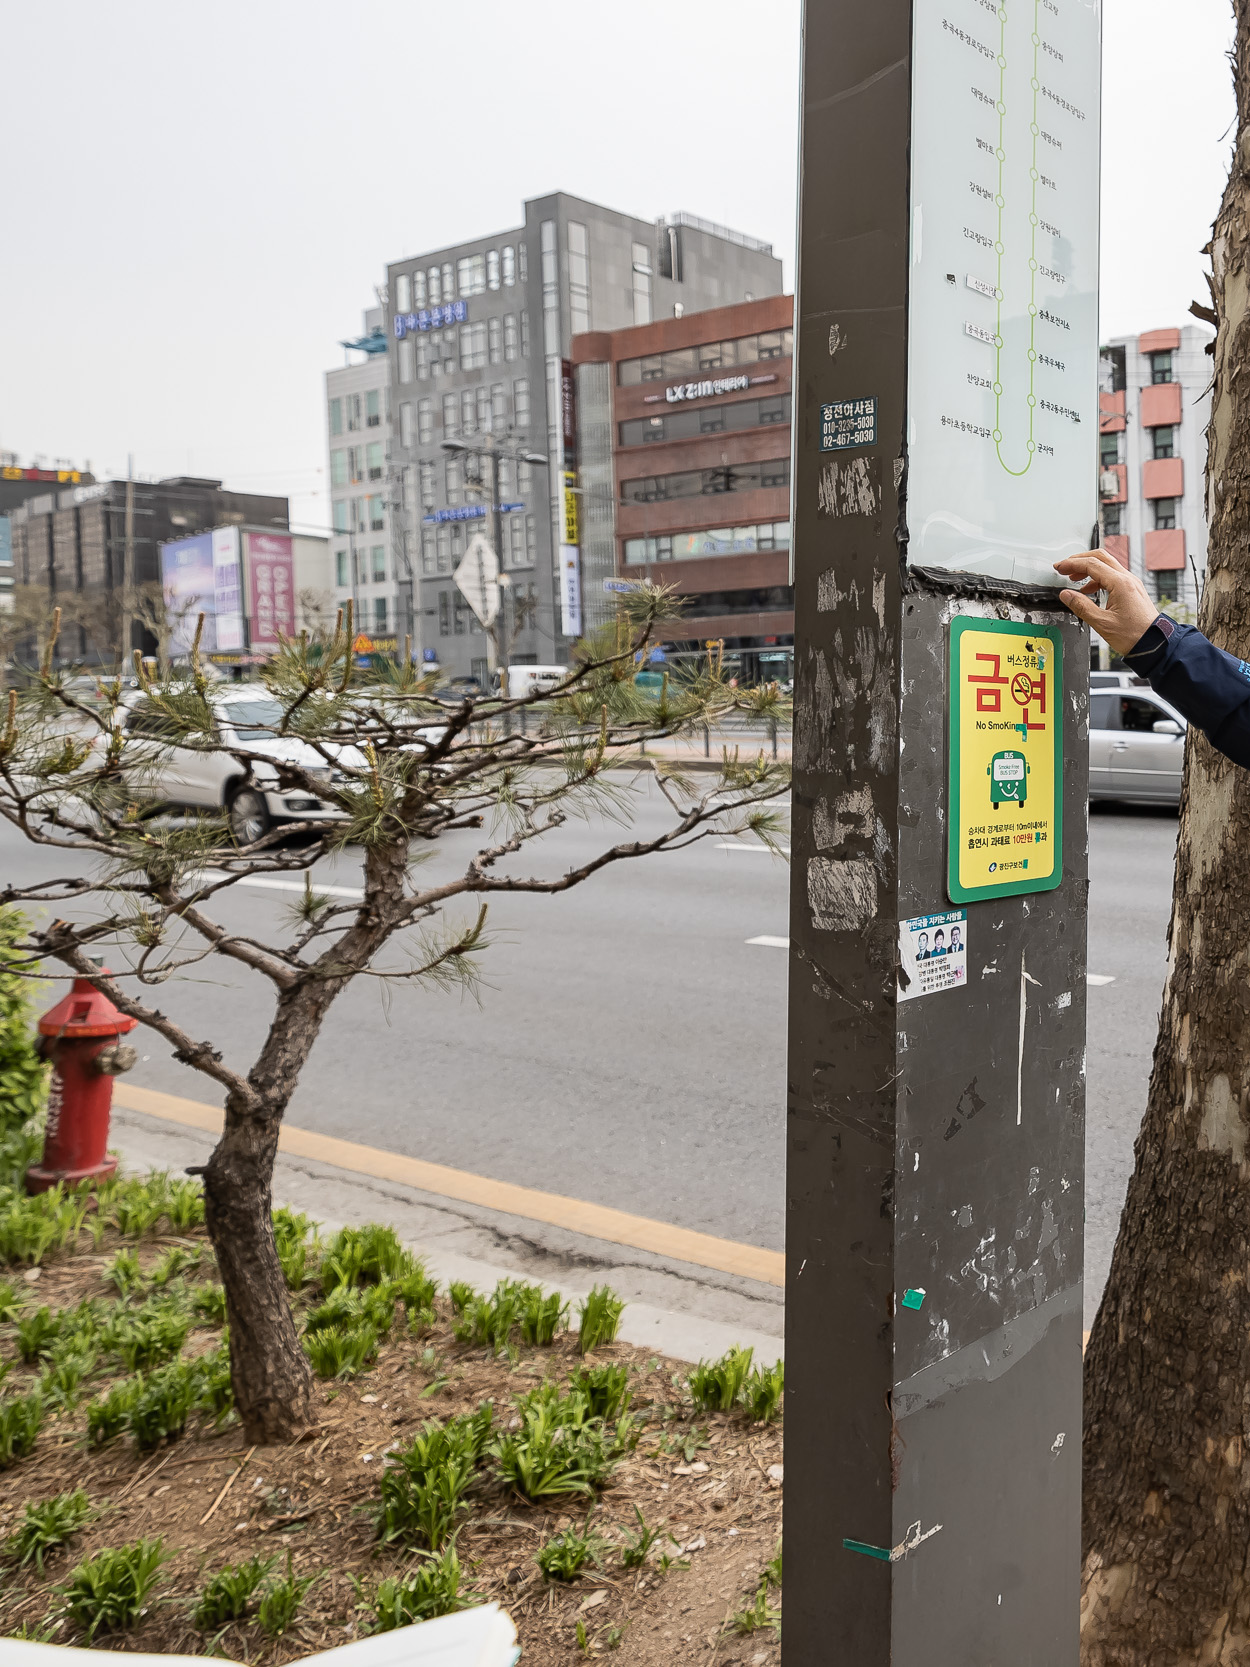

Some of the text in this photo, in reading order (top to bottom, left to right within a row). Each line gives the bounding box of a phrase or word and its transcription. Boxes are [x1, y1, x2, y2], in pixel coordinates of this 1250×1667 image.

[942, 18, 996, 60] 중곡4동경로당입구
[970, 87, 996, 109] 대명슈퍼
[1041, 86, 1086, 121] 중곡4동경로당입구
[969, 181, 994, 202] 강원설비
[962, 226, 994, 248] 긴고랑입구
[1039, 264, 1067, 285] 긴고랑입구
[974, 279, 997, 297] 신성시장
[967, 323, 997, 343] 중곡동입구
[1038, 353, 1066, 372] 중곡우체국
[966, 373, 992, 390] 찬양교회
[940, 414, 992, 439] 용마초등학교입구
[823, 429, 874, 448] 02-467-5030
[1037, 443, 1054, 457] 군자역
[1007, 653, 1042, 669] 버스정류
[975, 721, 1019, 731] No SmoKin
[967, 820, 1048, 836] 승차대 경계로부터 10m이내에서
[968, 831, 1048, 849] 흡연시 과태료 10만원 과
[999, 860, 1025, 871] 광진구보건
